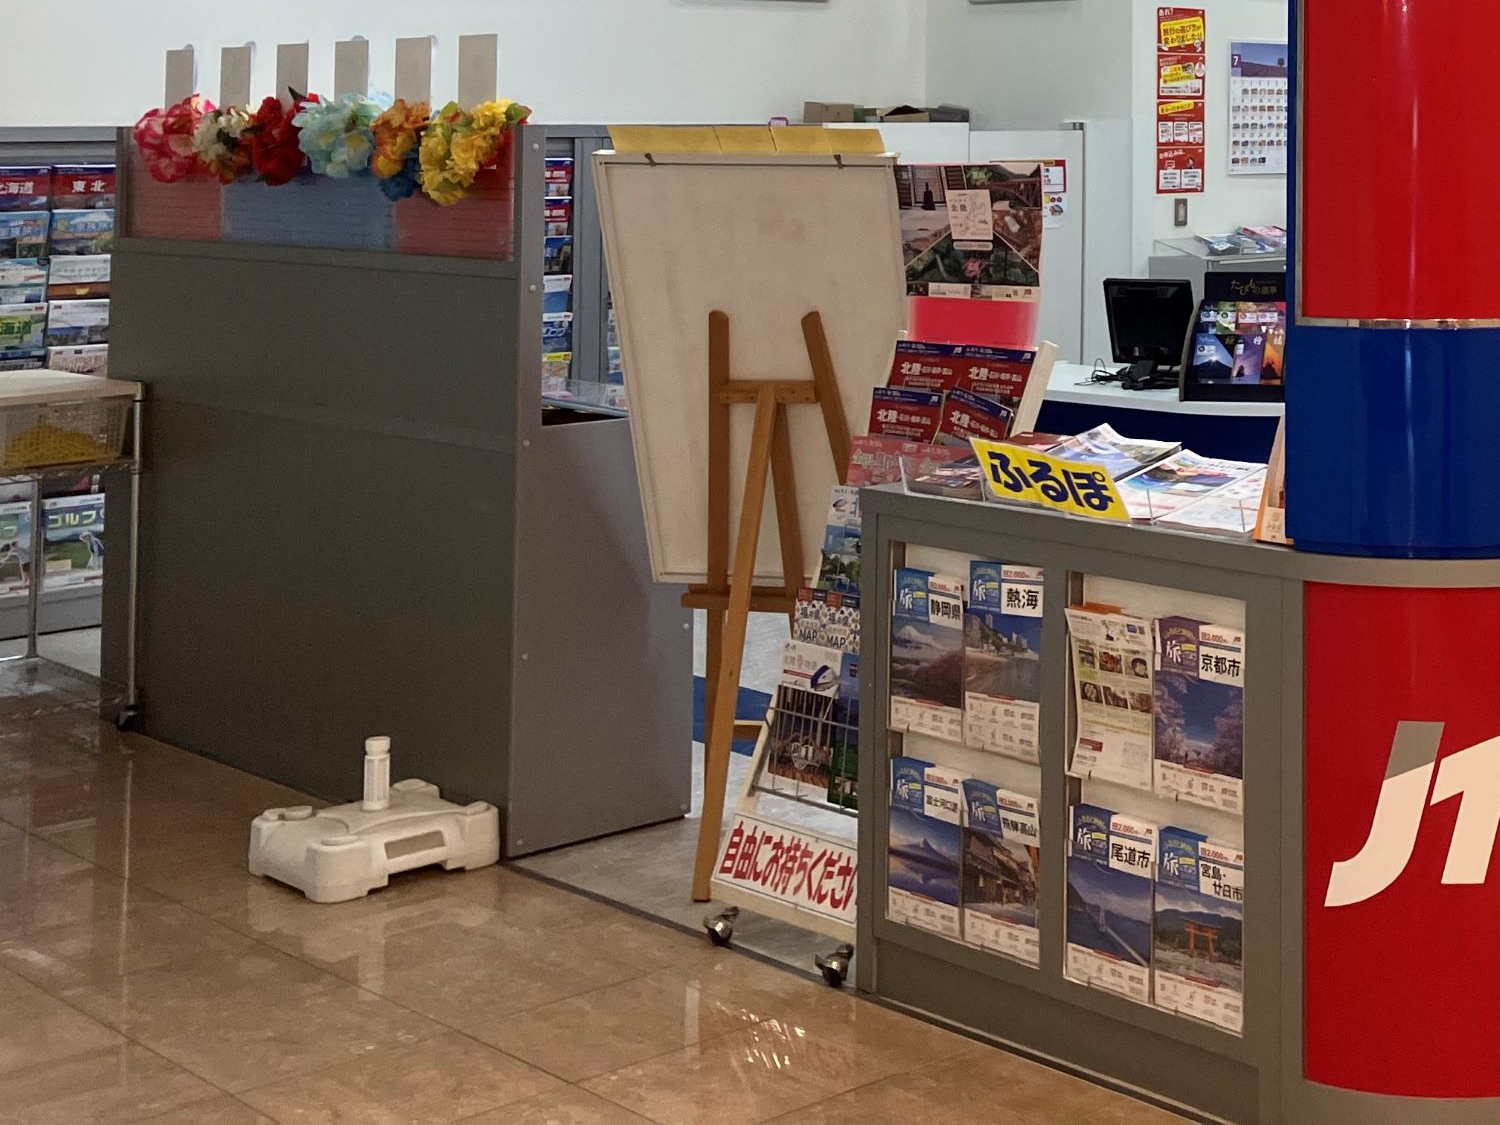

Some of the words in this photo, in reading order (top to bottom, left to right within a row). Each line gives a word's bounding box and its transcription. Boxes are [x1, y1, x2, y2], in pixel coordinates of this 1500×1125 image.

[1232, 55, 1240, 67] 7
[71, 179, 106, 194] 東北
[987, 450, 1114, 512] ふるぽ
[899, 587, 914, 611] 旅
[930, 598, 962, 621] 静岡県
[972, 578, 987, 603] 旅
[1006, 587, 1041, 610] 熱海
[826, 632, 847, 648] MAP
[1166, 639, 1182, 664] 旅
[1200, 653, 1242, 678] 京都市
[896, 778, 910, 801] 旅
[971, 800, 986, 823] 旅
[1076, 827, 1093, 852] 旅
[1110, 842, 1151, 869] 尾道市
[1163, 851, 1179, 876] 旅
[1211, 880, 1244, 902] 廿日市
